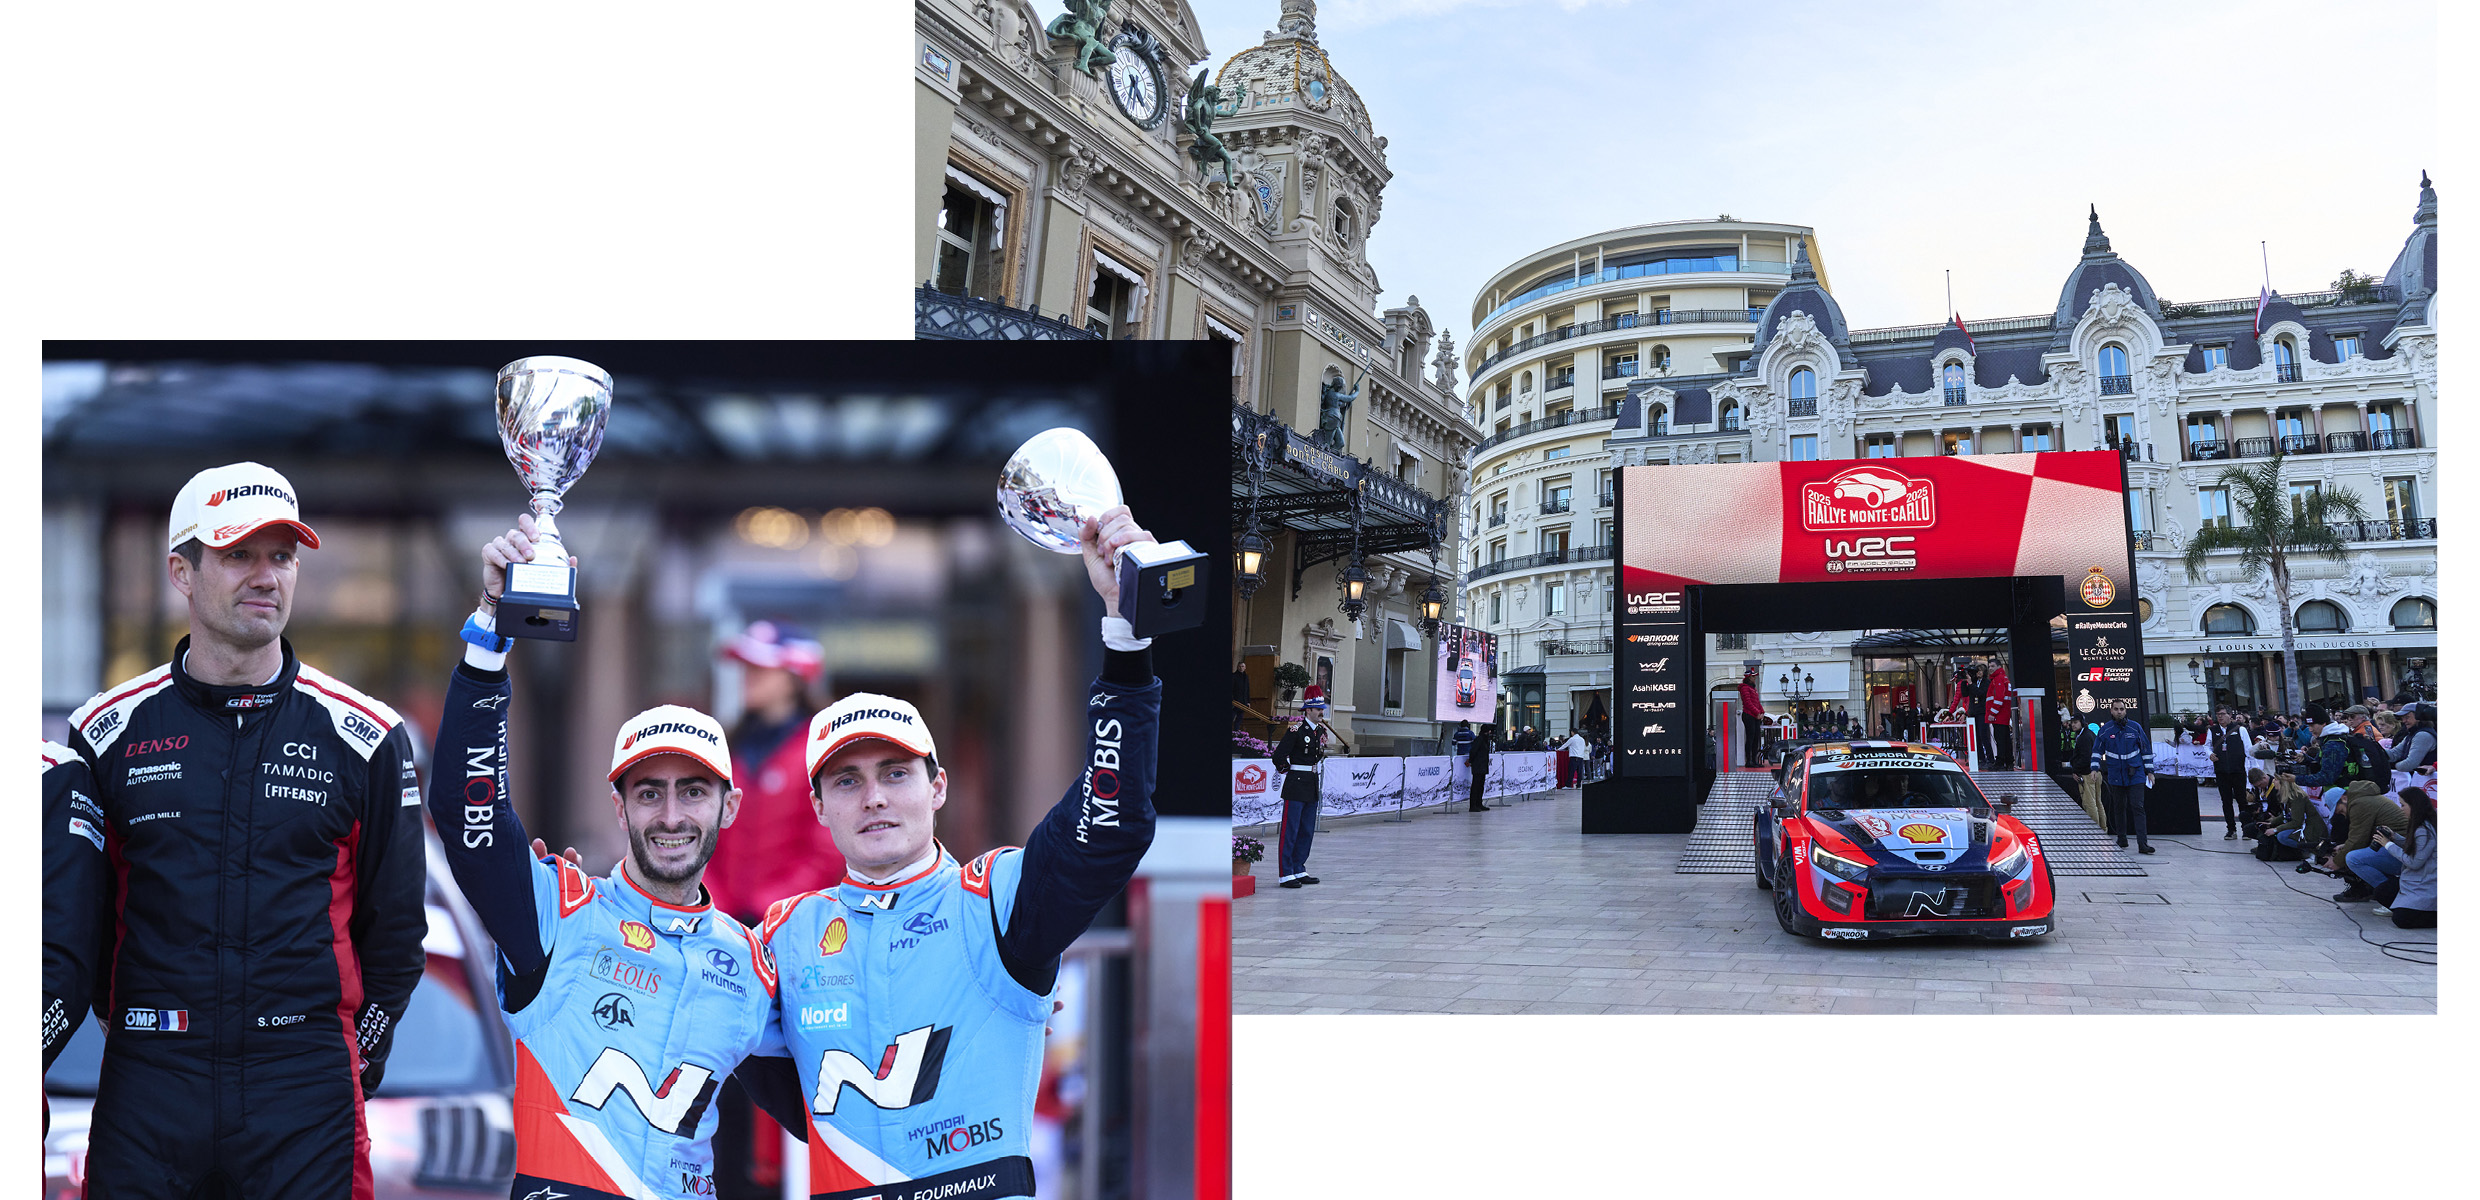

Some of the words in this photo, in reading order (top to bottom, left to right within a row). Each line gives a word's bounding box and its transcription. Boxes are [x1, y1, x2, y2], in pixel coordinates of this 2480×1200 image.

[1304, 444, 1334, 464] CASINO
[1807, 489, 1831, 506] 2025
[1905, 486, 1928, 504] 2025
[1808, 499, 1847, 525] RALLYE
[1849, 496, 1930, 523] MONTE-CARLO
[1825, 536, 1916, 558] WRC
[1627, 592, 1681, 605] WRC
[2079, 648, 2089, 656] LE
[2090, 647, 2127, 656] CASINO
[2259, 643, 2275, 651] XV
[2322, 640, 2378, 649] DUCASSE
[2077, 672, 2103, 682] GR
[226, 698, 252, 708] GR
[88, 710, 120, 741] OMP
[343, 715, 380, 743] OMP
[125, 735, 190, 758] DENSO
[126, 771, 183, 787] AUTOMOTIVE
[128, 761, 182, 778] Panasonic
[262, 762, 334, 784] TAMADIC
[1091, 718, 1123, 828] MOBIS
[463, 746, 496, 849] MOBIS
[1076, 765, 1094, 844] HYUNDAI
[157, 811, 182, 819] MILLE
[1889, 812, 1964, 822] MOBIS
[701, 968, 748, 998] HYUNDAI
[820, 974, 855, 987] STORES
[125, 1011, 157, 1027] OMP
[257, 1016, 269, 1027] S.
[271, 1014, 306, 1027] OGIER
[801, 1002, 848, 1026] Nord
[908, 1115, 965, 1142] HYUNDAI
[926, 1117, 1004, 1160] MOBIS
[914, 1174, 997, 1200] FOURMAUX
